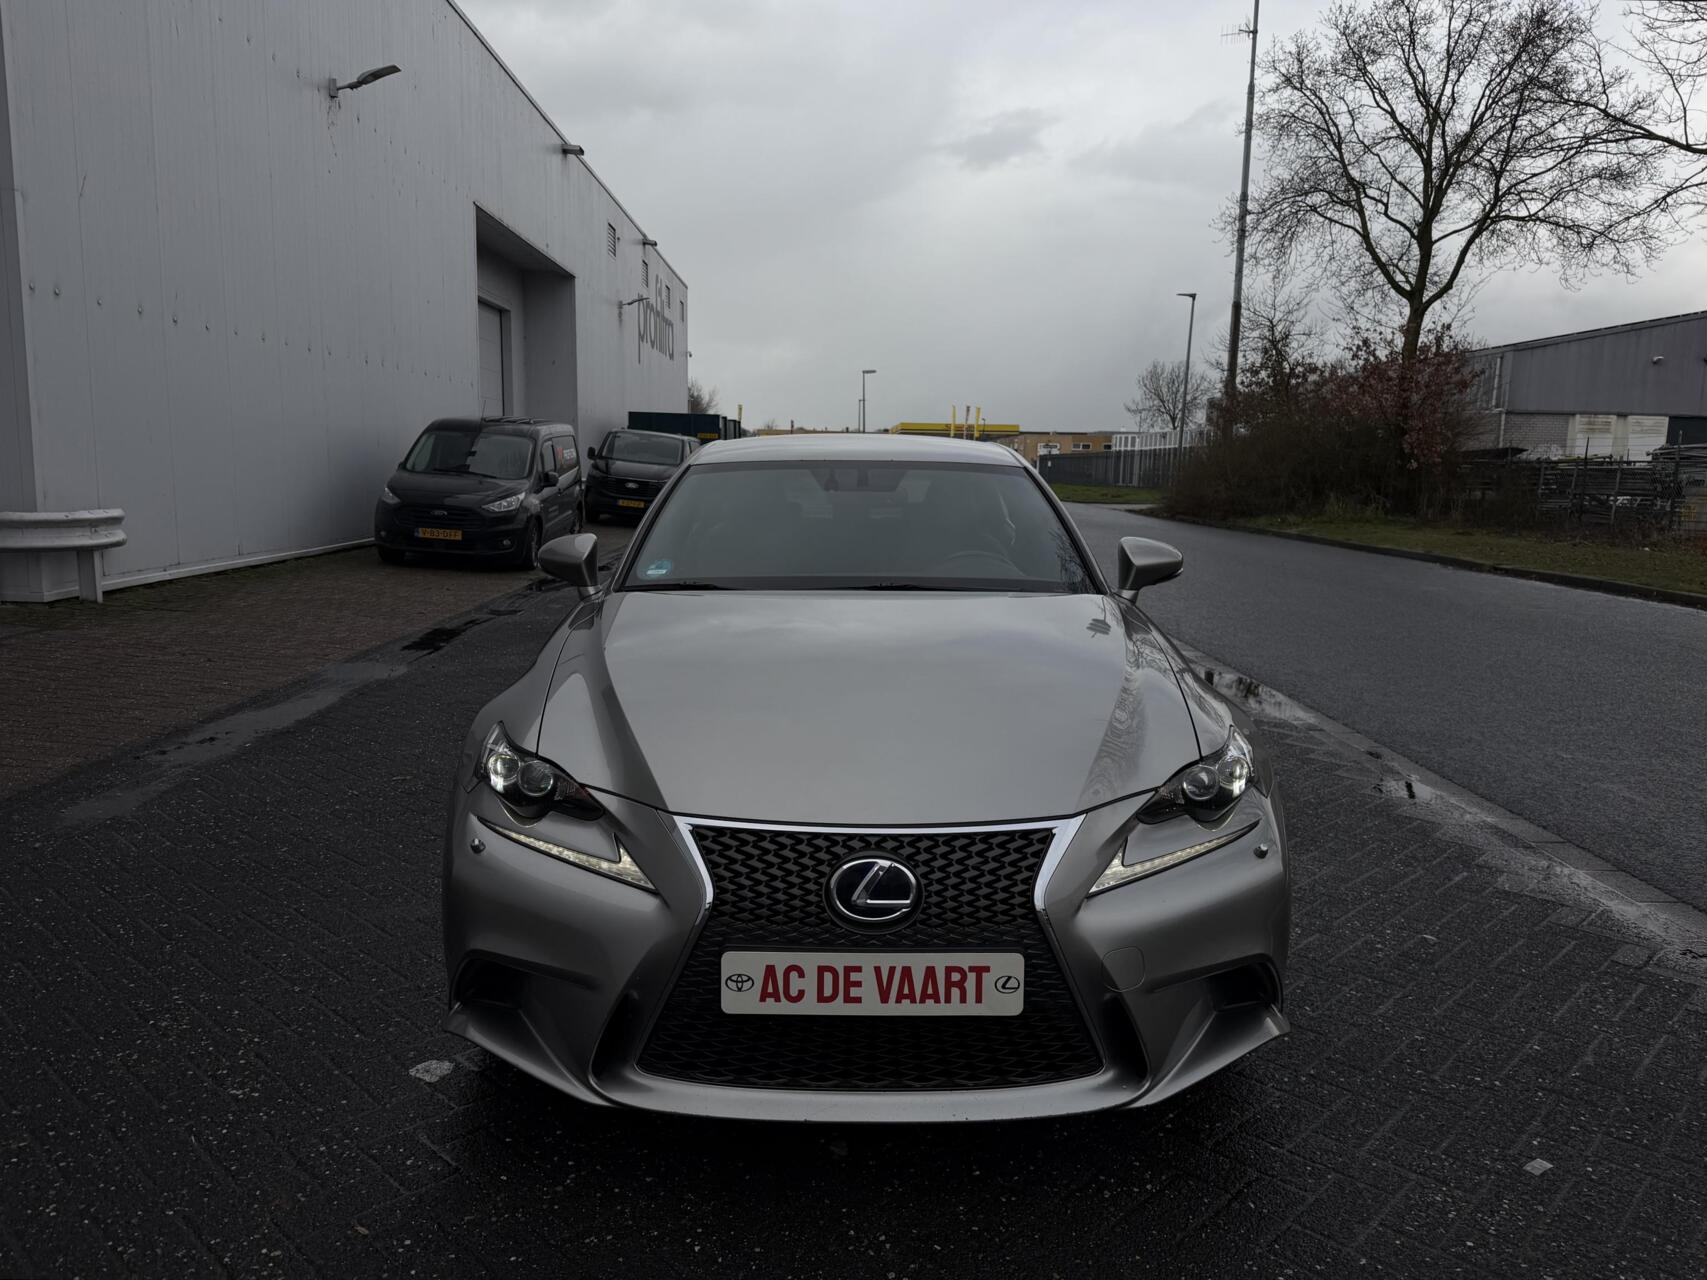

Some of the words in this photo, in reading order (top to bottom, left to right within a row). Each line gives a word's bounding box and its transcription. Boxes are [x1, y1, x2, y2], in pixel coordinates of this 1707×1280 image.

[758, 964, 806, 1004] AC
[816, 965, 863, 1004] DE
[873, 965, 991, 1005] VAART
